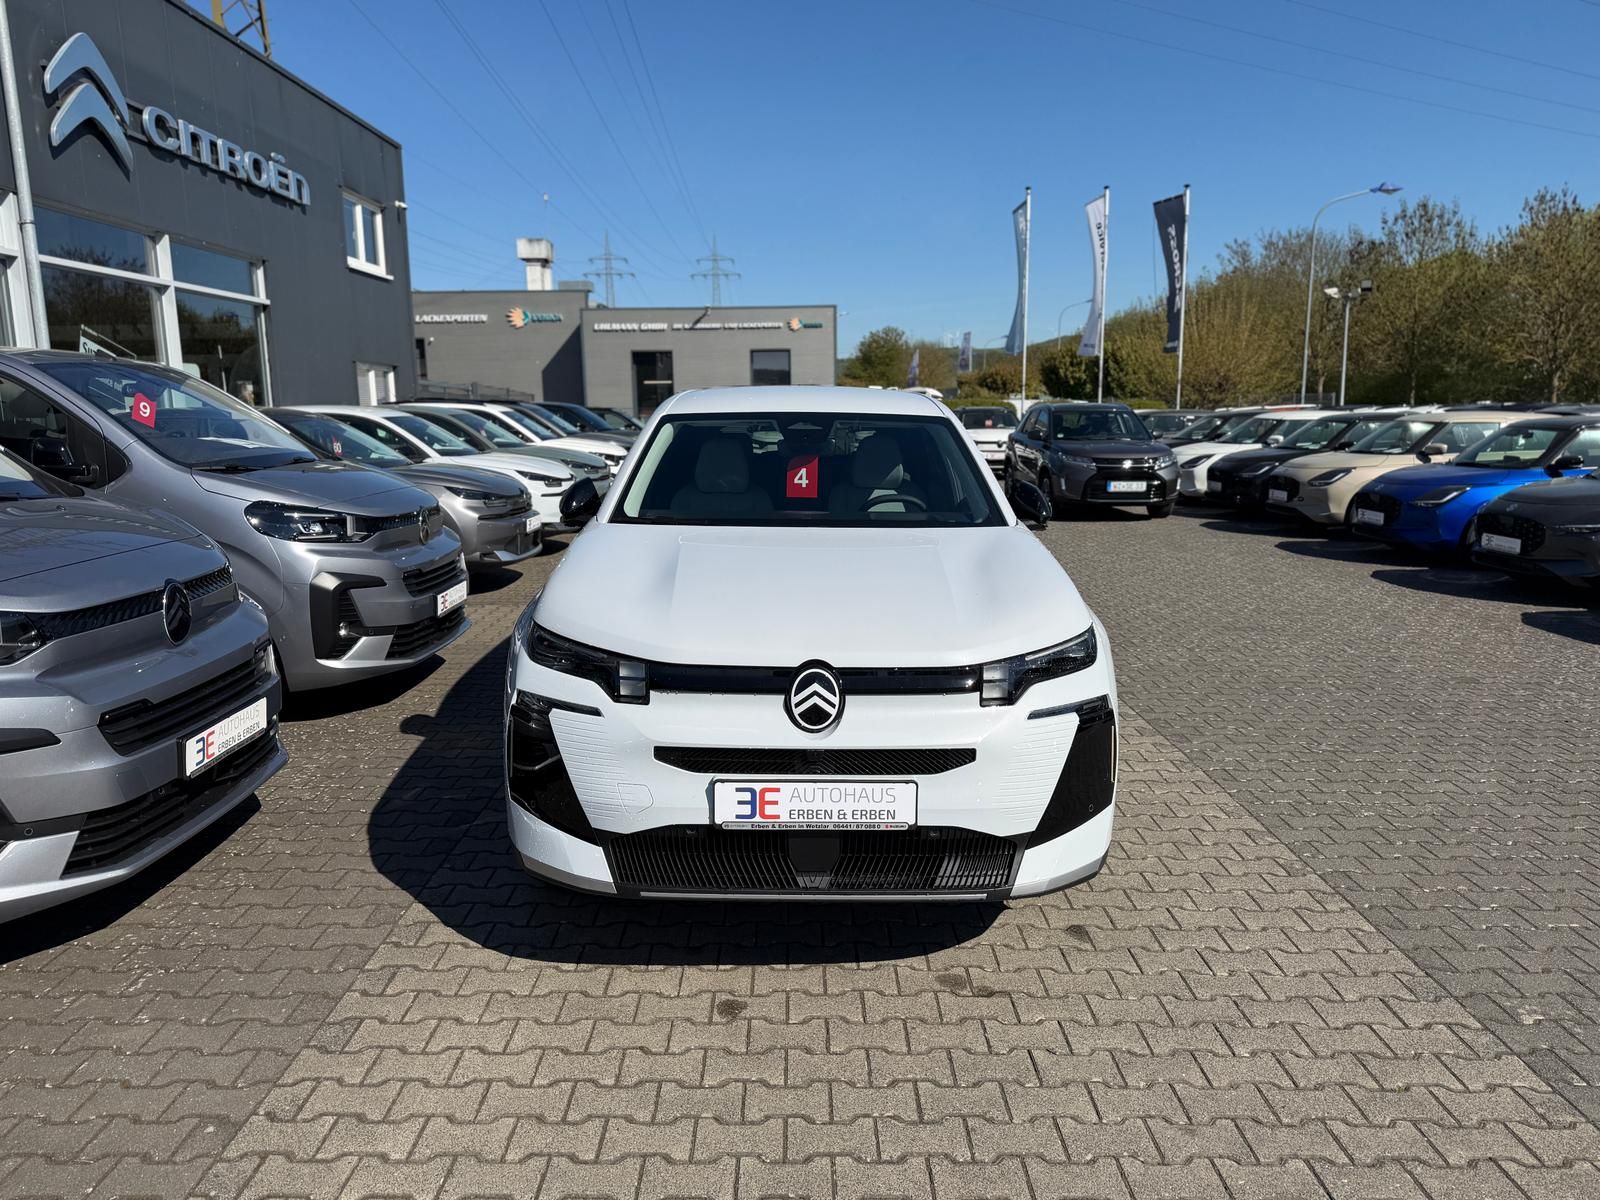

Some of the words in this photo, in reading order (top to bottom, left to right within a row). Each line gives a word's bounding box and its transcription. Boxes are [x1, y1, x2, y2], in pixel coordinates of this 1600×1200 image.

[142, 105, 311, 206] CITROËN
[415, 314, 488, 323] LACKEXPERTEN
[139, 401, 151, 417] 9
[793, 467, 809, 488] 4
[218, 705, 260, 739] AUTOHAUS
[217, 734, 236, 753] ERBEN
[242, 721, 260, 738] ERBEN
[788, 787, 896, 804] AUTOHAUS
[788, 809, 833, 820] ERBEN
[837, 809, 848, 820] &
[851, 809, 896, 820] ERBEN
